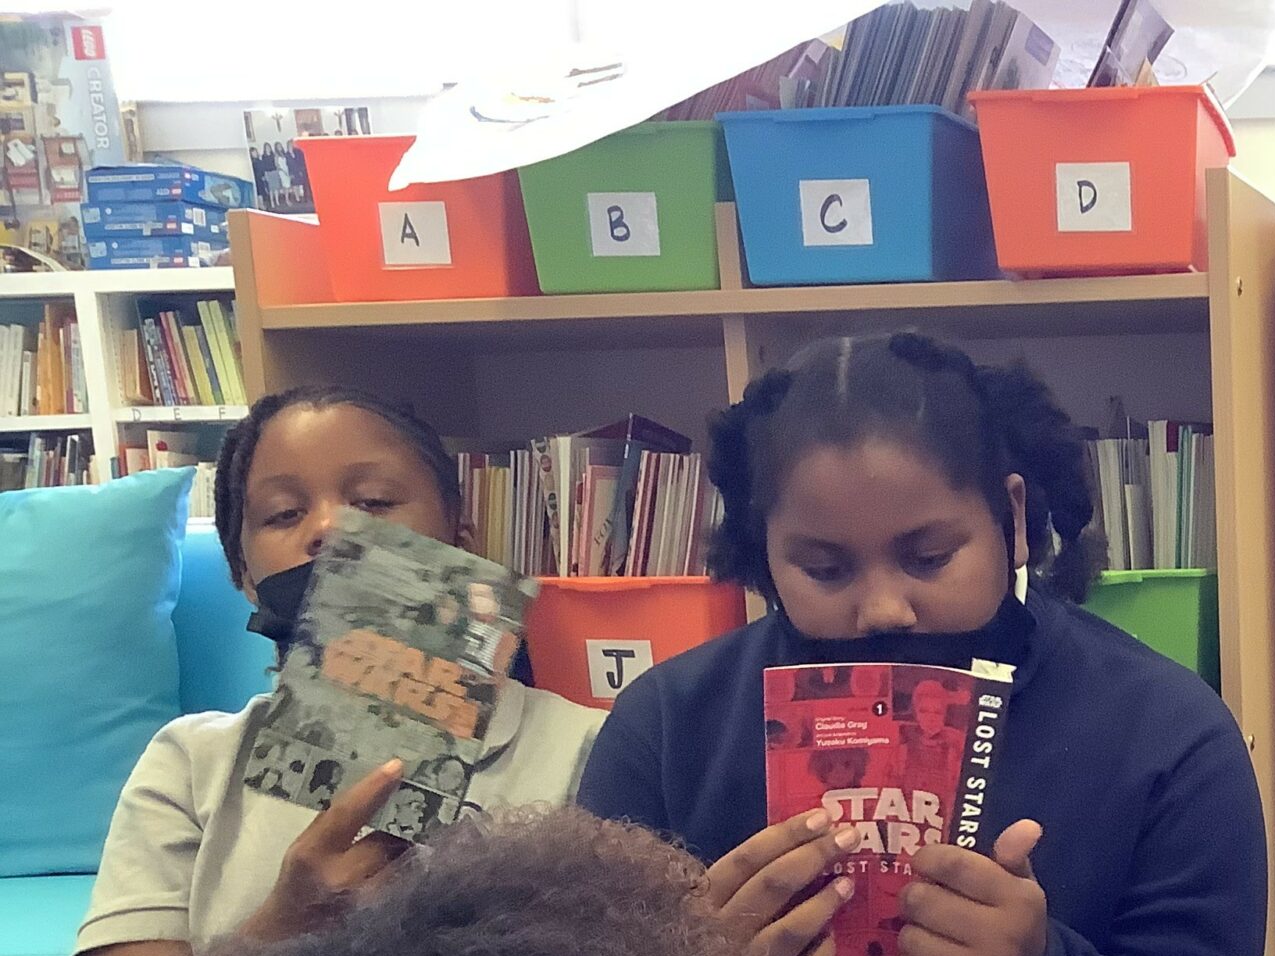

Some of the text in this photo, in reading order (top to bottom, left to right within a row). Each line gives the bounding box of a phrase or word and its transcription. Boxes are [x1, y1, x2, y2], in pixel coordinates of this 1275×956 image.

[87, 66, 111, 150] CREATOR
[819, 193, 848, 234] C
[1076, 179, 1098, 214] D
[400, 212, 420, 247] A
[606, 205, 631, 242] B
[131, 408, 142, 422] D
[174, 407, 182, 421] E
[218, 406, 227, 420] F
[601, 648, 636, 690] J
[970, 710, 998, 769] LOST
[820, 786, 944, 830] STAR
[956, 776, 986, 848] STARS
